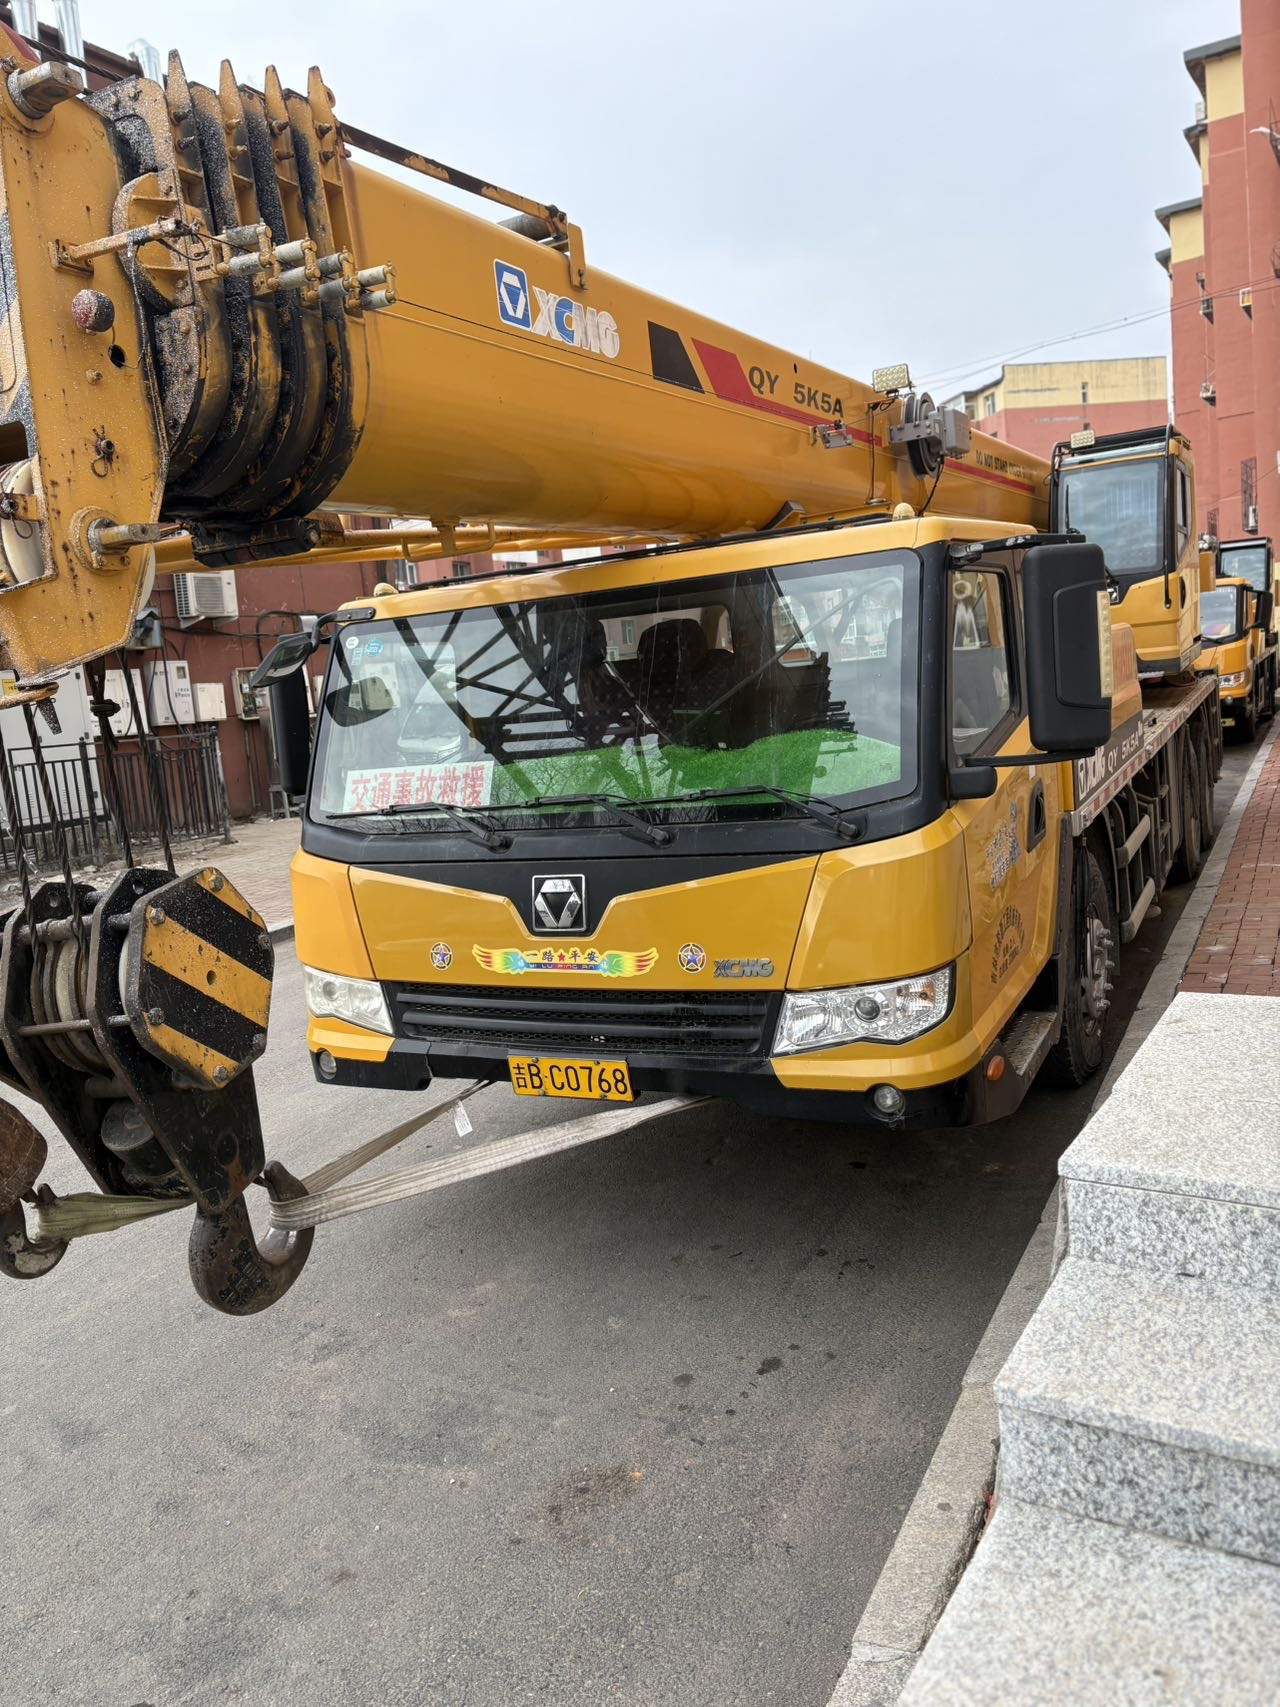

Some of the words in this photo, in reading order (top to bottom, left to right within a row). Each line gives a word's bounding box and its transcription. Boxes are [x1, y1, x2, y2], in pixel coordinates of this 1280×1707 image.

[531, 285, 620, 358] XCMG
[748, 366, 779, 395] QY
[793, 382, 844, 418] 5K5A
[1107, 745, 1119, 773] QY
[351, 764, 486, 811] 交通事故救援
[527, 950, 599, 963] 一路平安
[714, 958, 775, 978] XCMG
